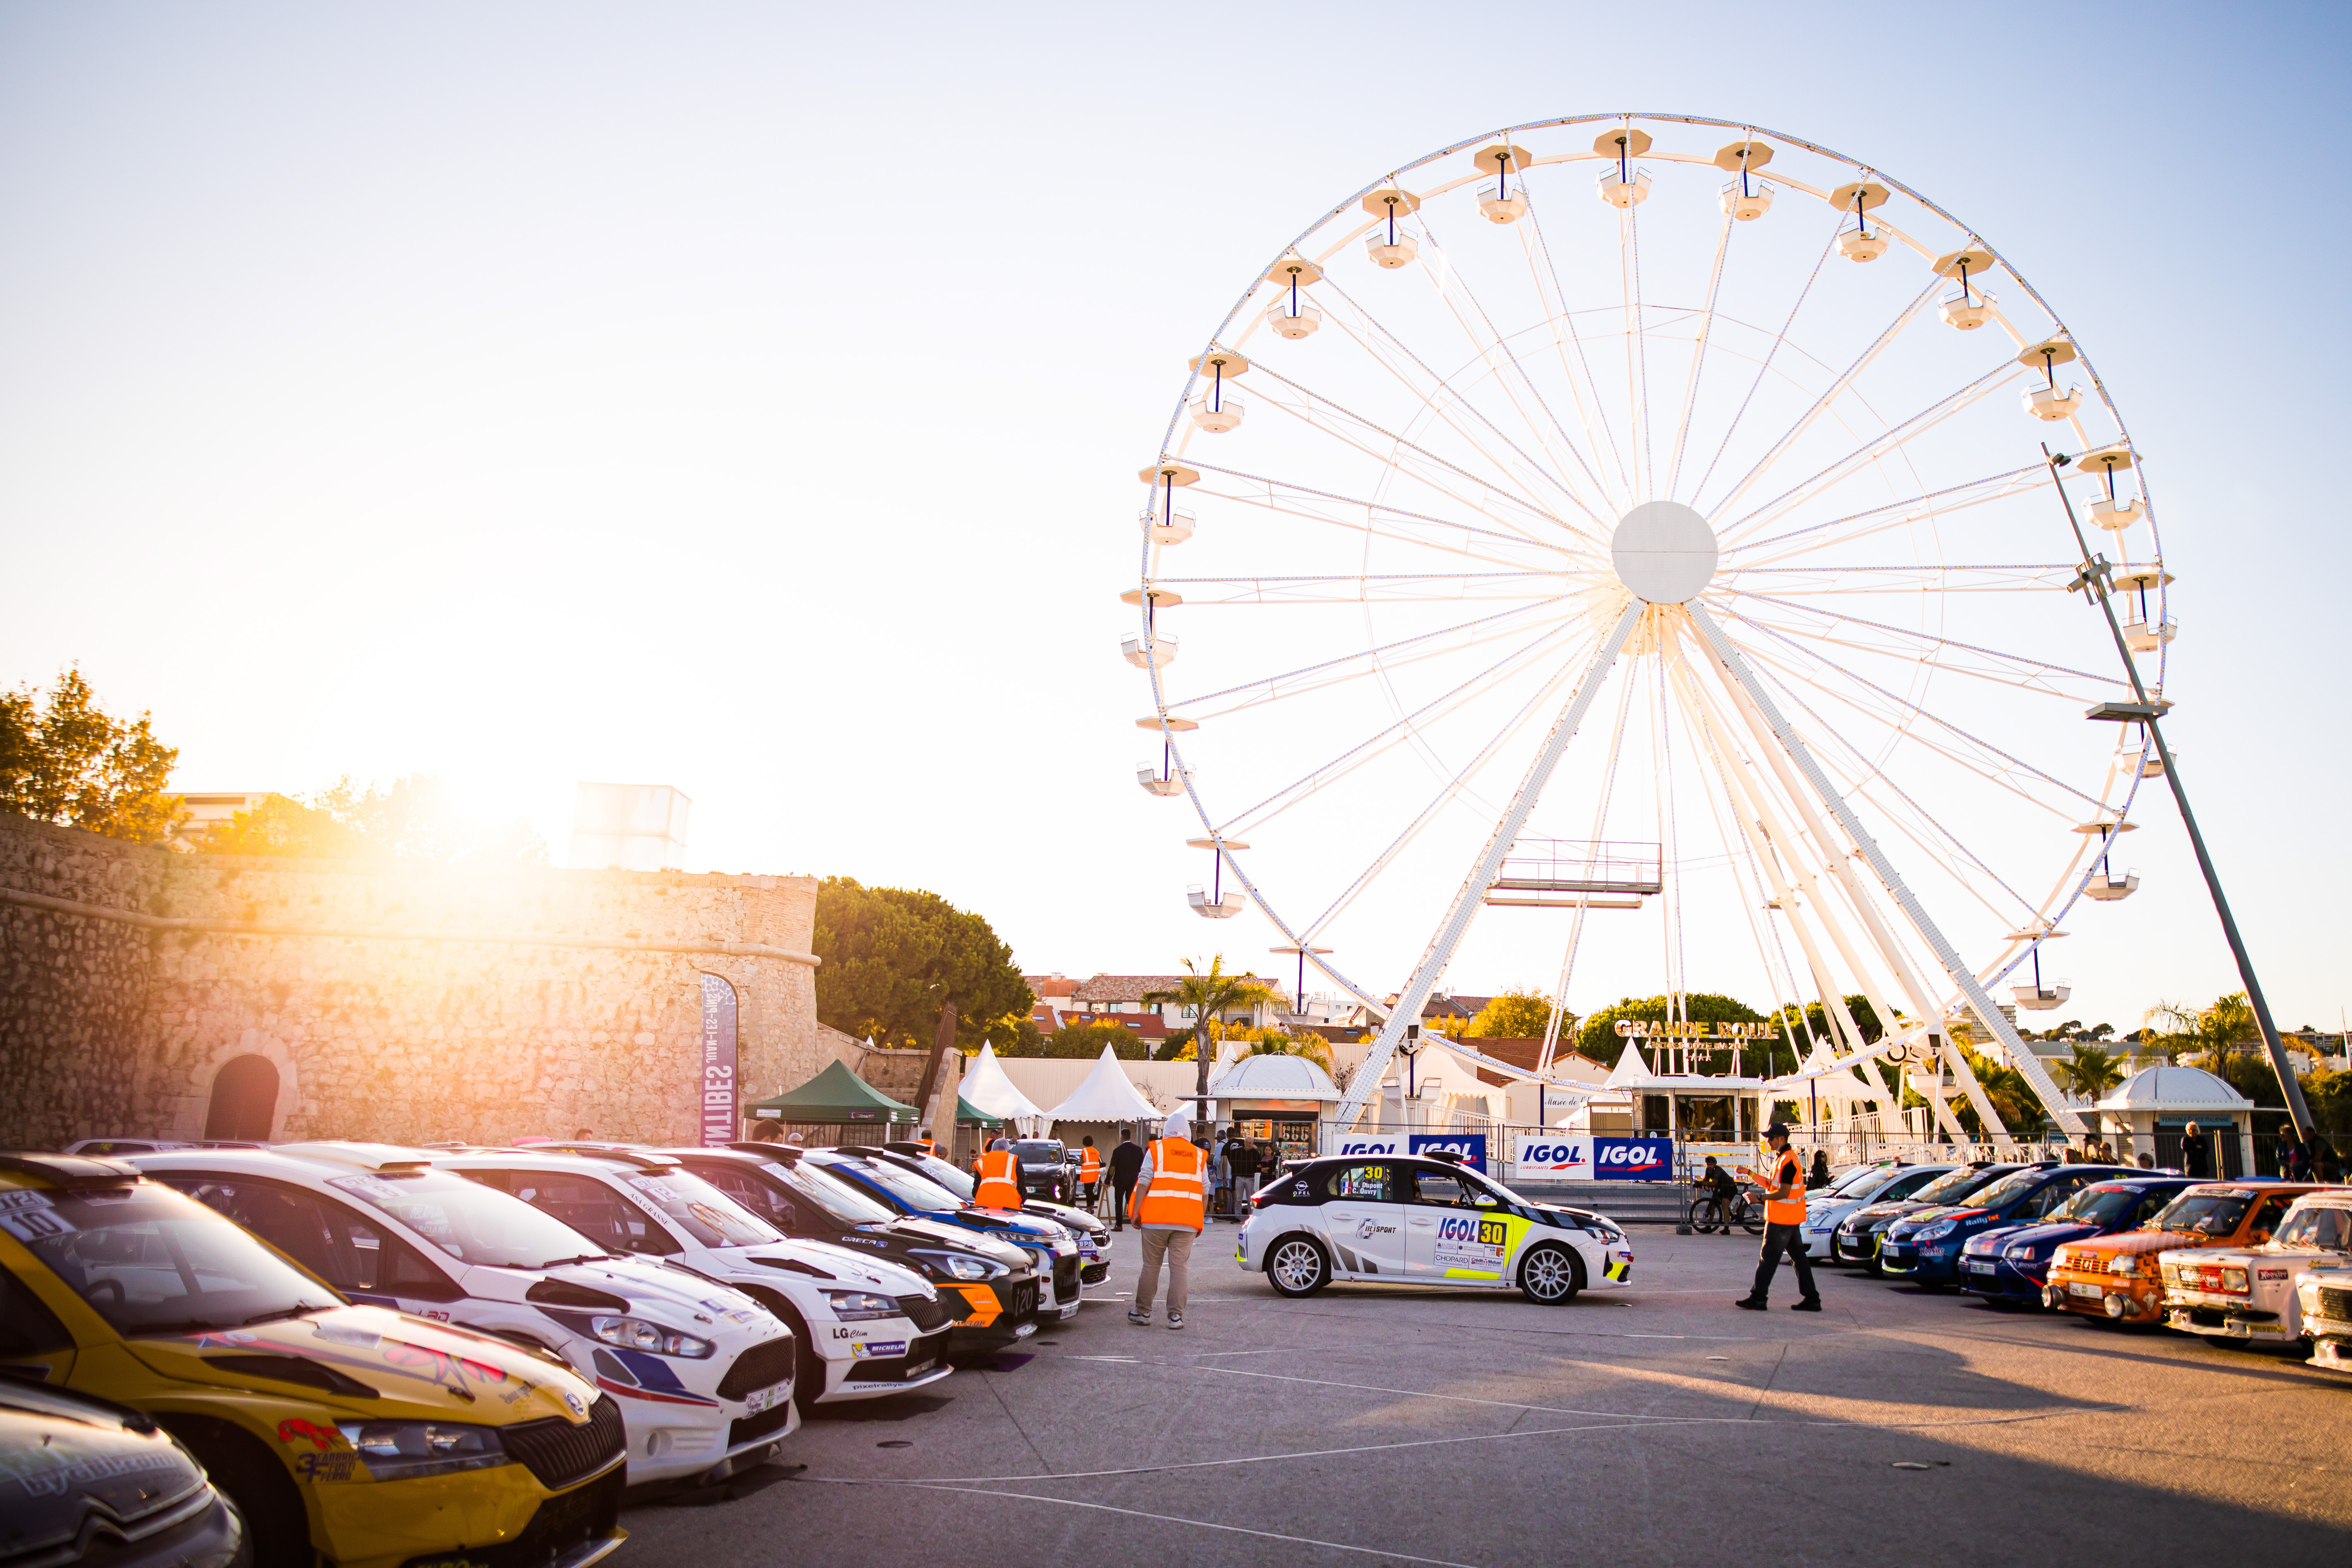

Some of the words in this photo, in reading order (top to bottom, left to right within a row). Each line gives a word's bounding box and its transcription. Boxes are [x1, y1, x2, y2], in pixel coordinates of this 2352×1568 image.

[1614, 1019, 1709, 1038] GRANDE
[1545, 1095, 1567, 1105] Musée
[1569, 1097, 1578, 1105] de
[1523, 1145, 1580, 1162] IGOL
[1599, 1146, 1657, 1164] IGOL
[1365, 1166, 1383, 1178] 30
[629, 1194, 642, 1204] ASA
[643, 1204, 669, 1226] GRASSE
[12, 1213, 63, 1238] 10
[1438, 1218, 1476, 1241] IGOL
[1481, 1223, 1503, 1244] 30
[842, 1237, 877, 1245] ORECA
[1436, 1255, 1468, 1263] CHOPARD
[833, 1328, 849, 1339] LG
[850, 1329, 868, 1338] Clim
